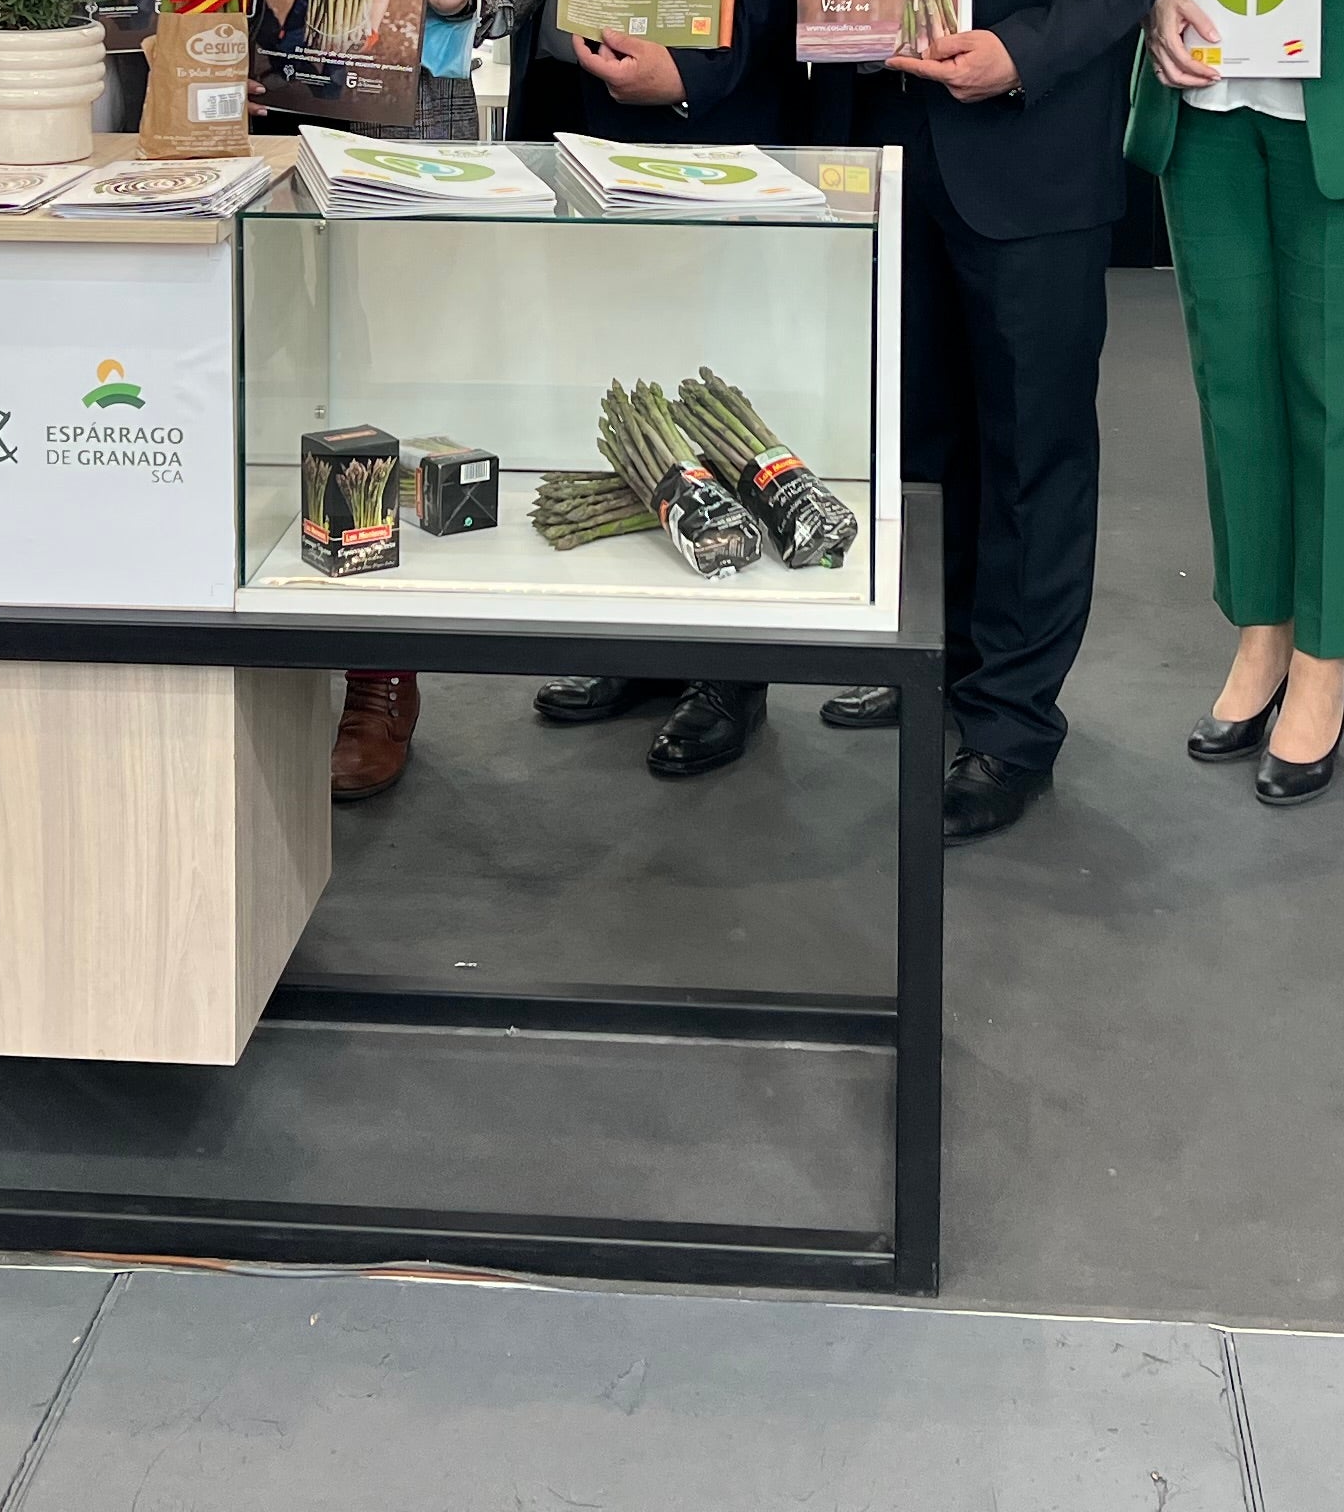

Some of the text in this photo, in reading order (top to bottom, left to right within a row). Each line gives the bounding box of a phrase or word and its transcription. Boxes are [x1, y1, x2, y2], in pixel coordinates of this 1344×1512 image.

[855, 3, 870, 12] us
[46, 422, 184, 445] ESPÁRRAGO
[46, 449, 183, 467] DE GRANADA
[151, 470, 184, 484] SCA
